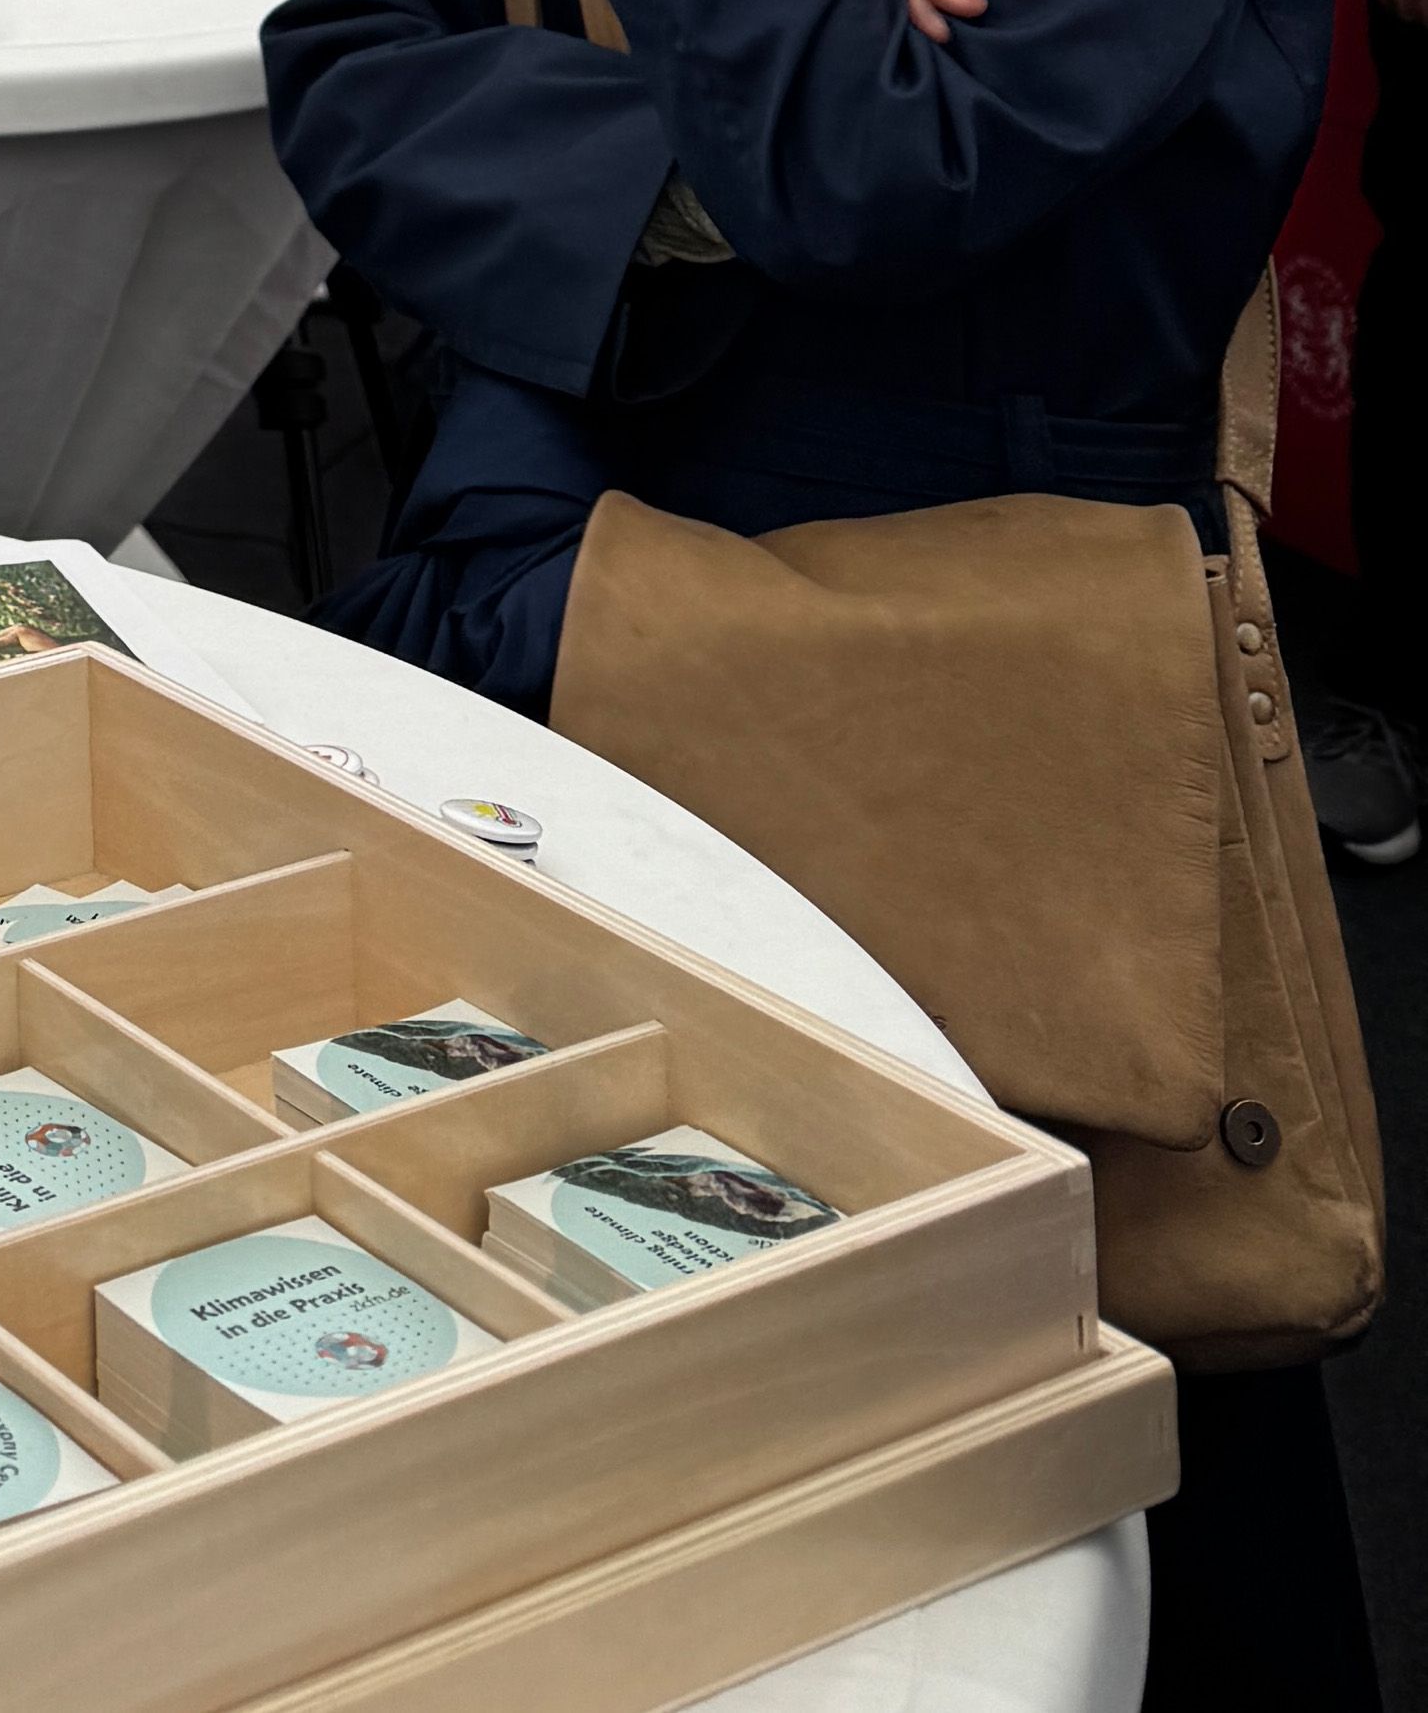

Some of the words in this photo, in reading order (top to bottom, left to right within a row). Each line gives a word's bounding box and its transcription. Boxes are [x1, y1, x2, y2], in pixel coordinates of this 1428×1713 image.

[347, 1063, 403, 1098] climate
[32, 1185, 57, 1203] in
[584, 1204, 647, 1245] climate
[190, 1264, 343, 1322] Klimawissen
[215, 1324, 249, 1341] in
[250, 1308, 292, 1330] die
[289, 1281, 366, 1314] Praxis
[348, 1285, 412, 1313] zkfn.de
